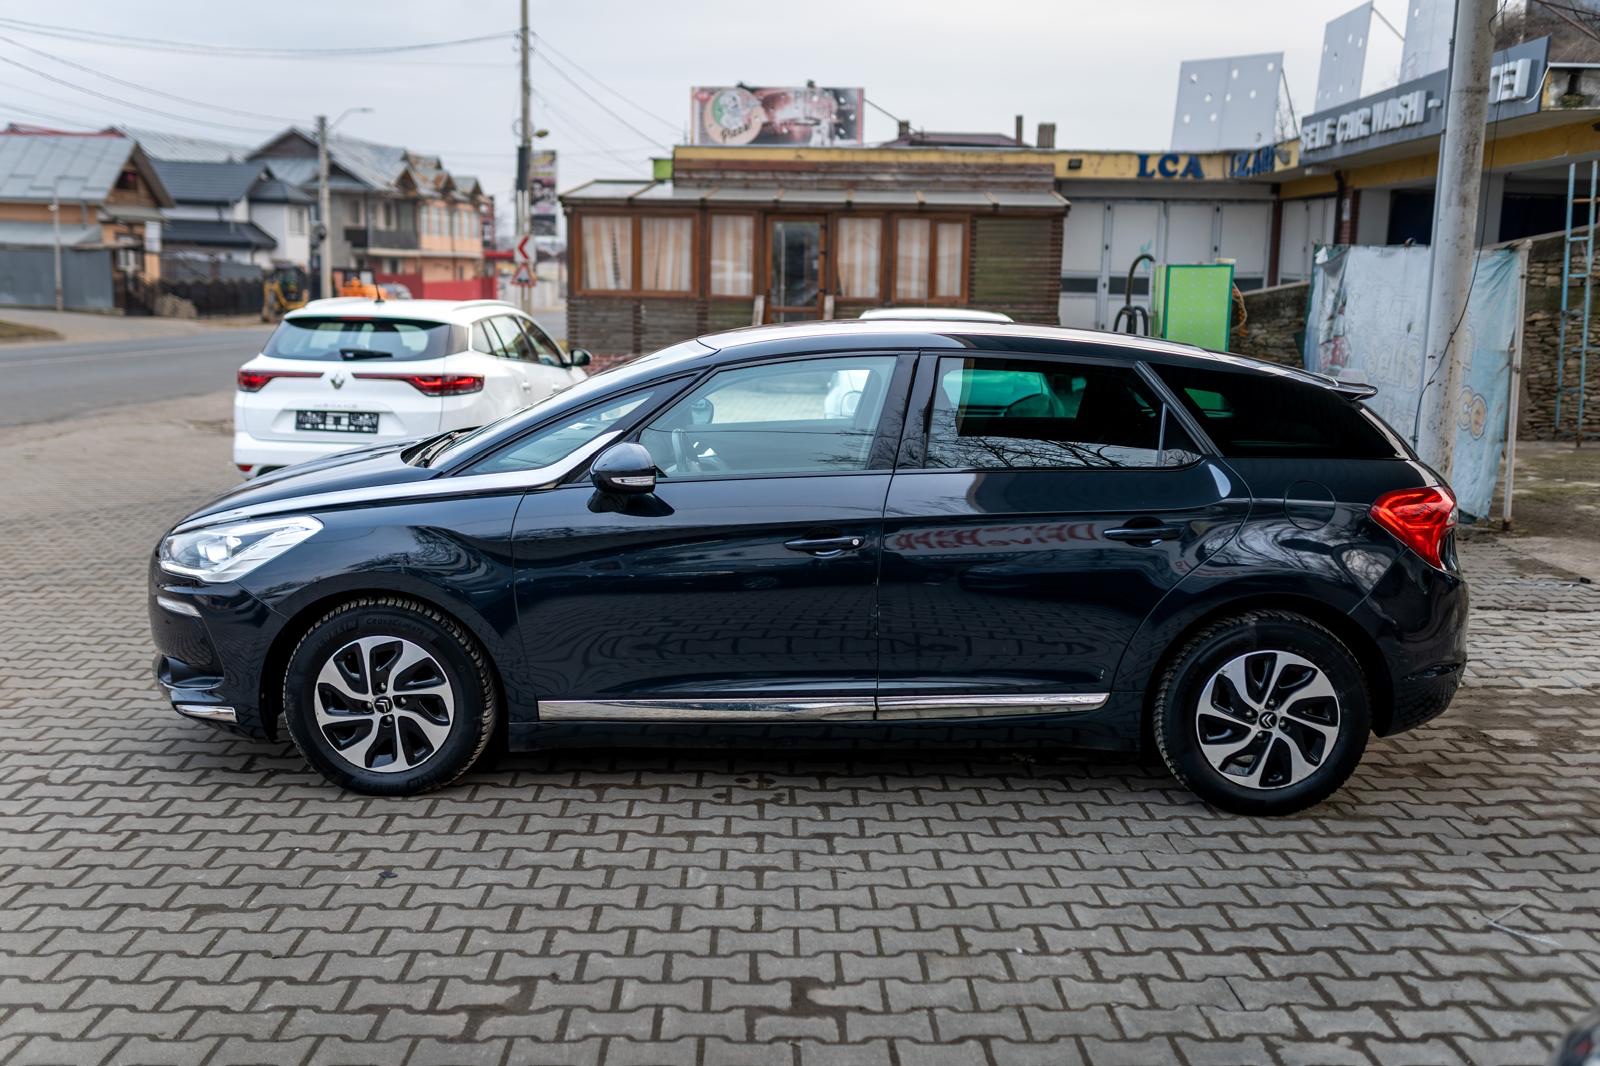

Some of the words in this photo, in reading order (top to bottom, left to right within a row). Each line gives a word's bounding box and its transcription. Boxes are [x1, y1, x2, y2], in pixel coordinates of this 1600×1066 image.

[1336, 107, 1372, 144] CAR
[1371, 90, 1427, 134] WASH
[1136, 153, 1205, 178] LCA
